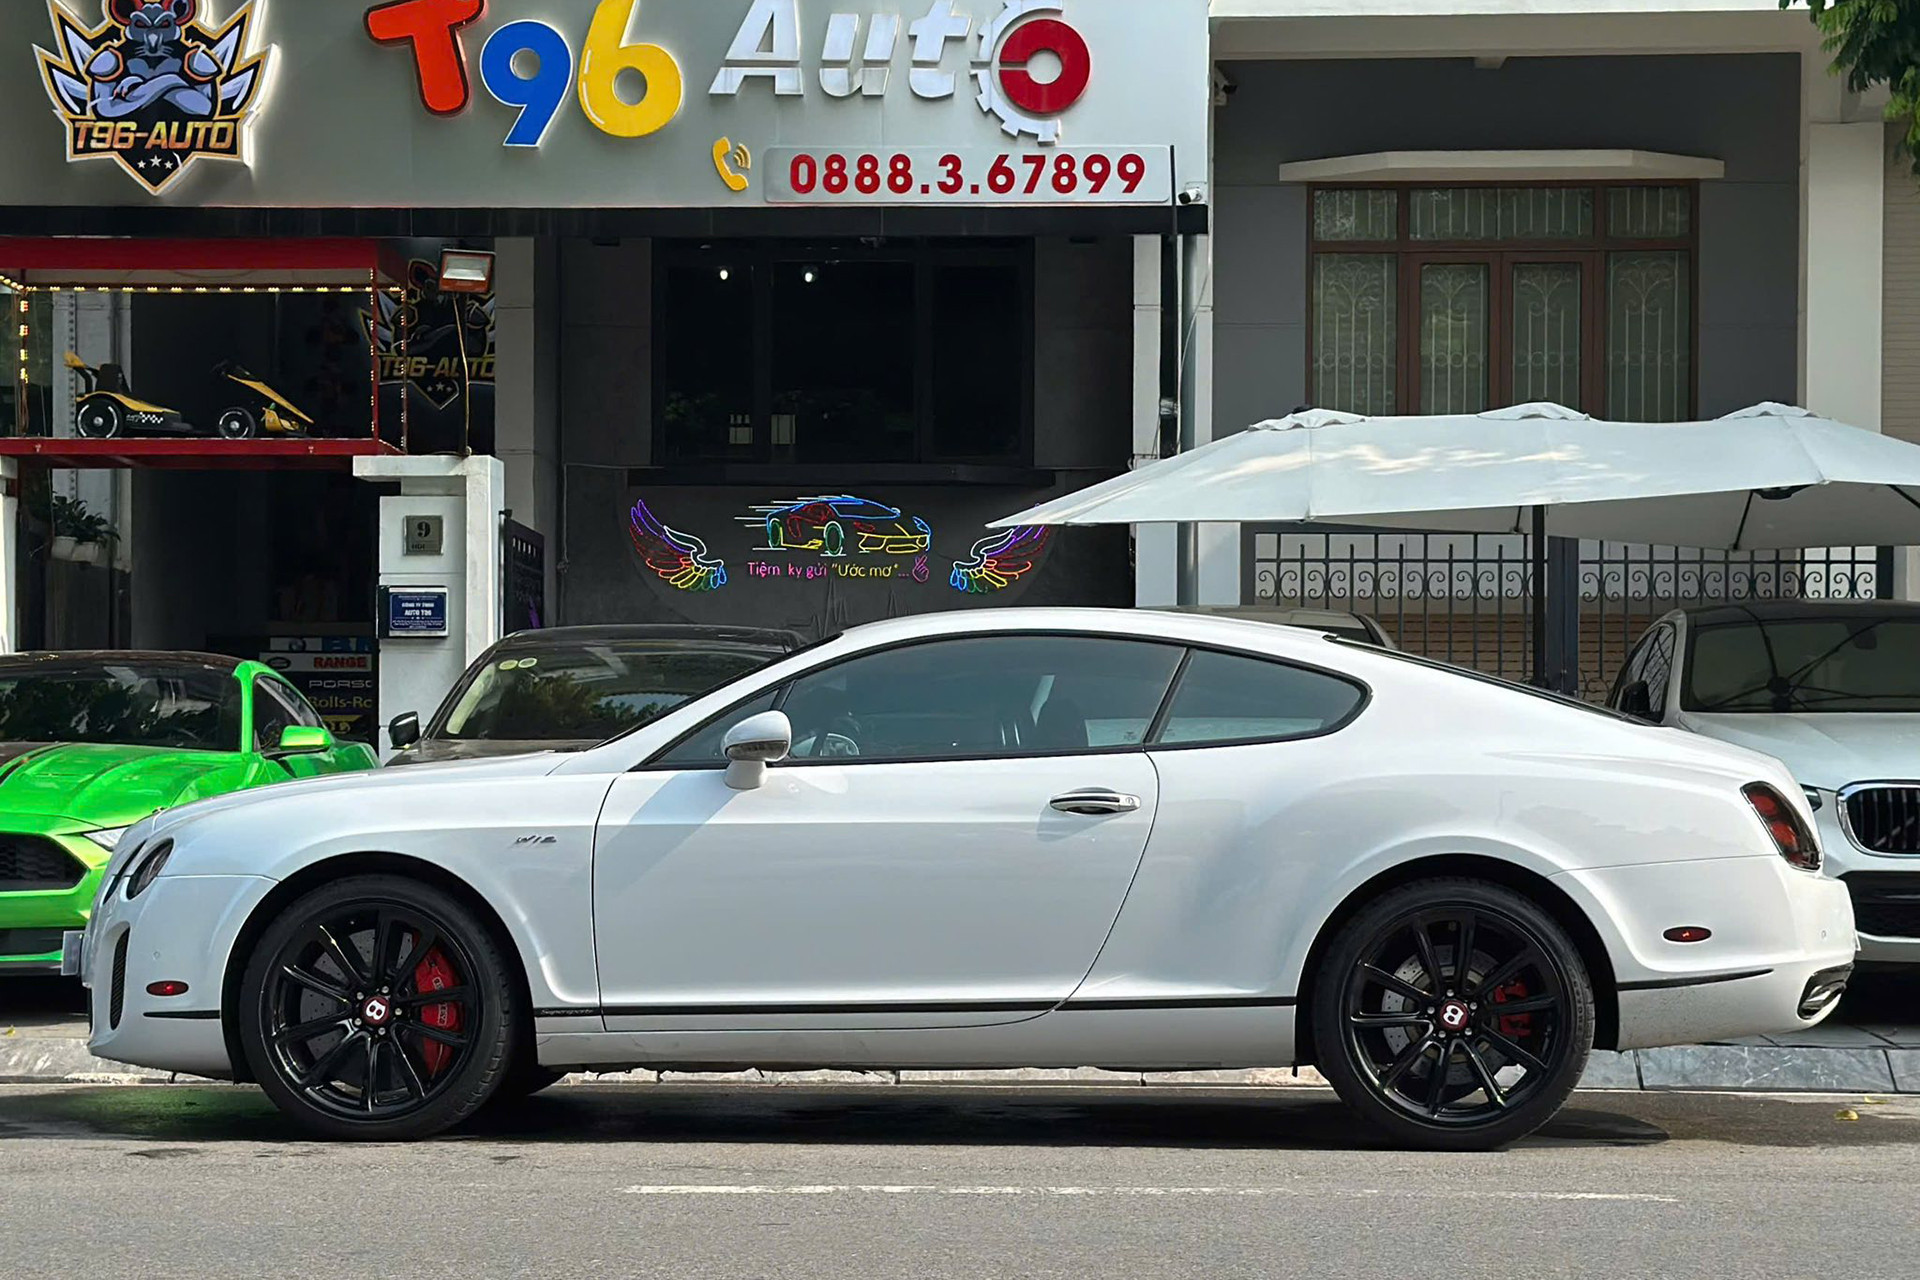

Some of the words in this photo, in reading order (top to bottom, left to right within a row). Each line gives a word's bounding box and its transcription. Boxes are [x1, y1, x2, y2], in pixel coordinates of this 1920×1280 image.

[363, 0, 683, 147] T96
[74, 120, 235, 149] T96-AUTO
[790, 153, 1146, 195] 0888.3.67899
[417, 521, 431, 538] 9
[313, 656, 367, 669] RANGE
